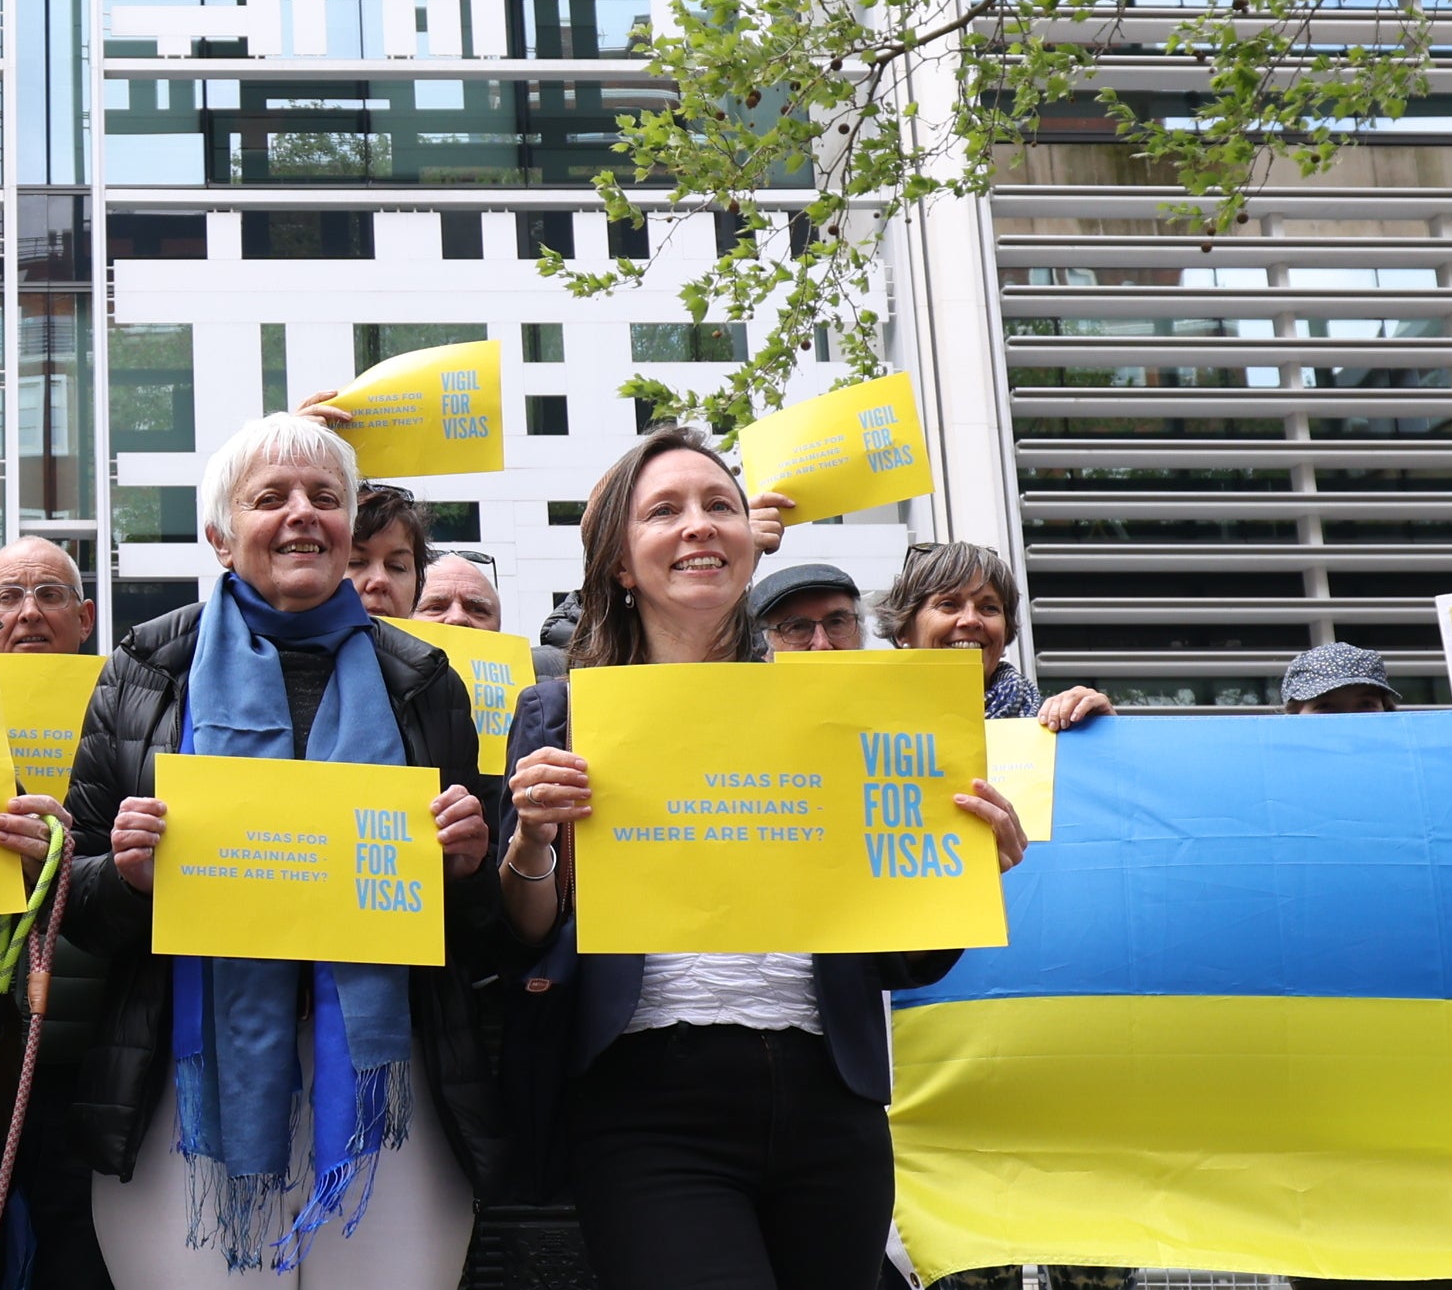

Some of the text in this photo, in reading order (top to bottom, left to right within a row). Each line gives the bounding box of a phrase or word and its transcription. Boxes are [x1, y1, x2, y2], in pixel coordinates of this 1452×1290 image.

[441, 371, 480, 392] VIGIL
[368, 393, 422, 403] VISAS FOR
[442, 393, 470, 415] FOR
[368, 420, 388, 428] ARE
[392, 417, 424, 426] THEY?
[442, 416, 488, 439] VISAS
[858, 405, 898, 429] VIGIL
[862, 428, 893, 451] FOR
[867, 445, 914, 473] VISAS
[471, 659, 516, 685] VIGIL
[474, 683, 506, 709] FOR
[475, 709, 512, 735] VISA
[8, 729, 73, 740] SAS FOR
[860, 733, 944, 777] VIGIL
[705, 773, 822, 788] VISAS FOR
[668, 801, 808, 815] UKRAINIANS
[864, 783, 923, 827] FOR
[354, 809, 412, 842] VIGIL
[613, 827, 824, 841] WHERE ARE THEY?
[247, 831, 328, 845] VISAS FOR
[219, 848, 318, 863] UKRAINIANS
[356, 843, 398, 876] FOR
[864, 833, 963, 877] VISAS
[180, 865, 328, 883] WHERE ARE THEY?
[355, 878, 422, 913] VISAS
